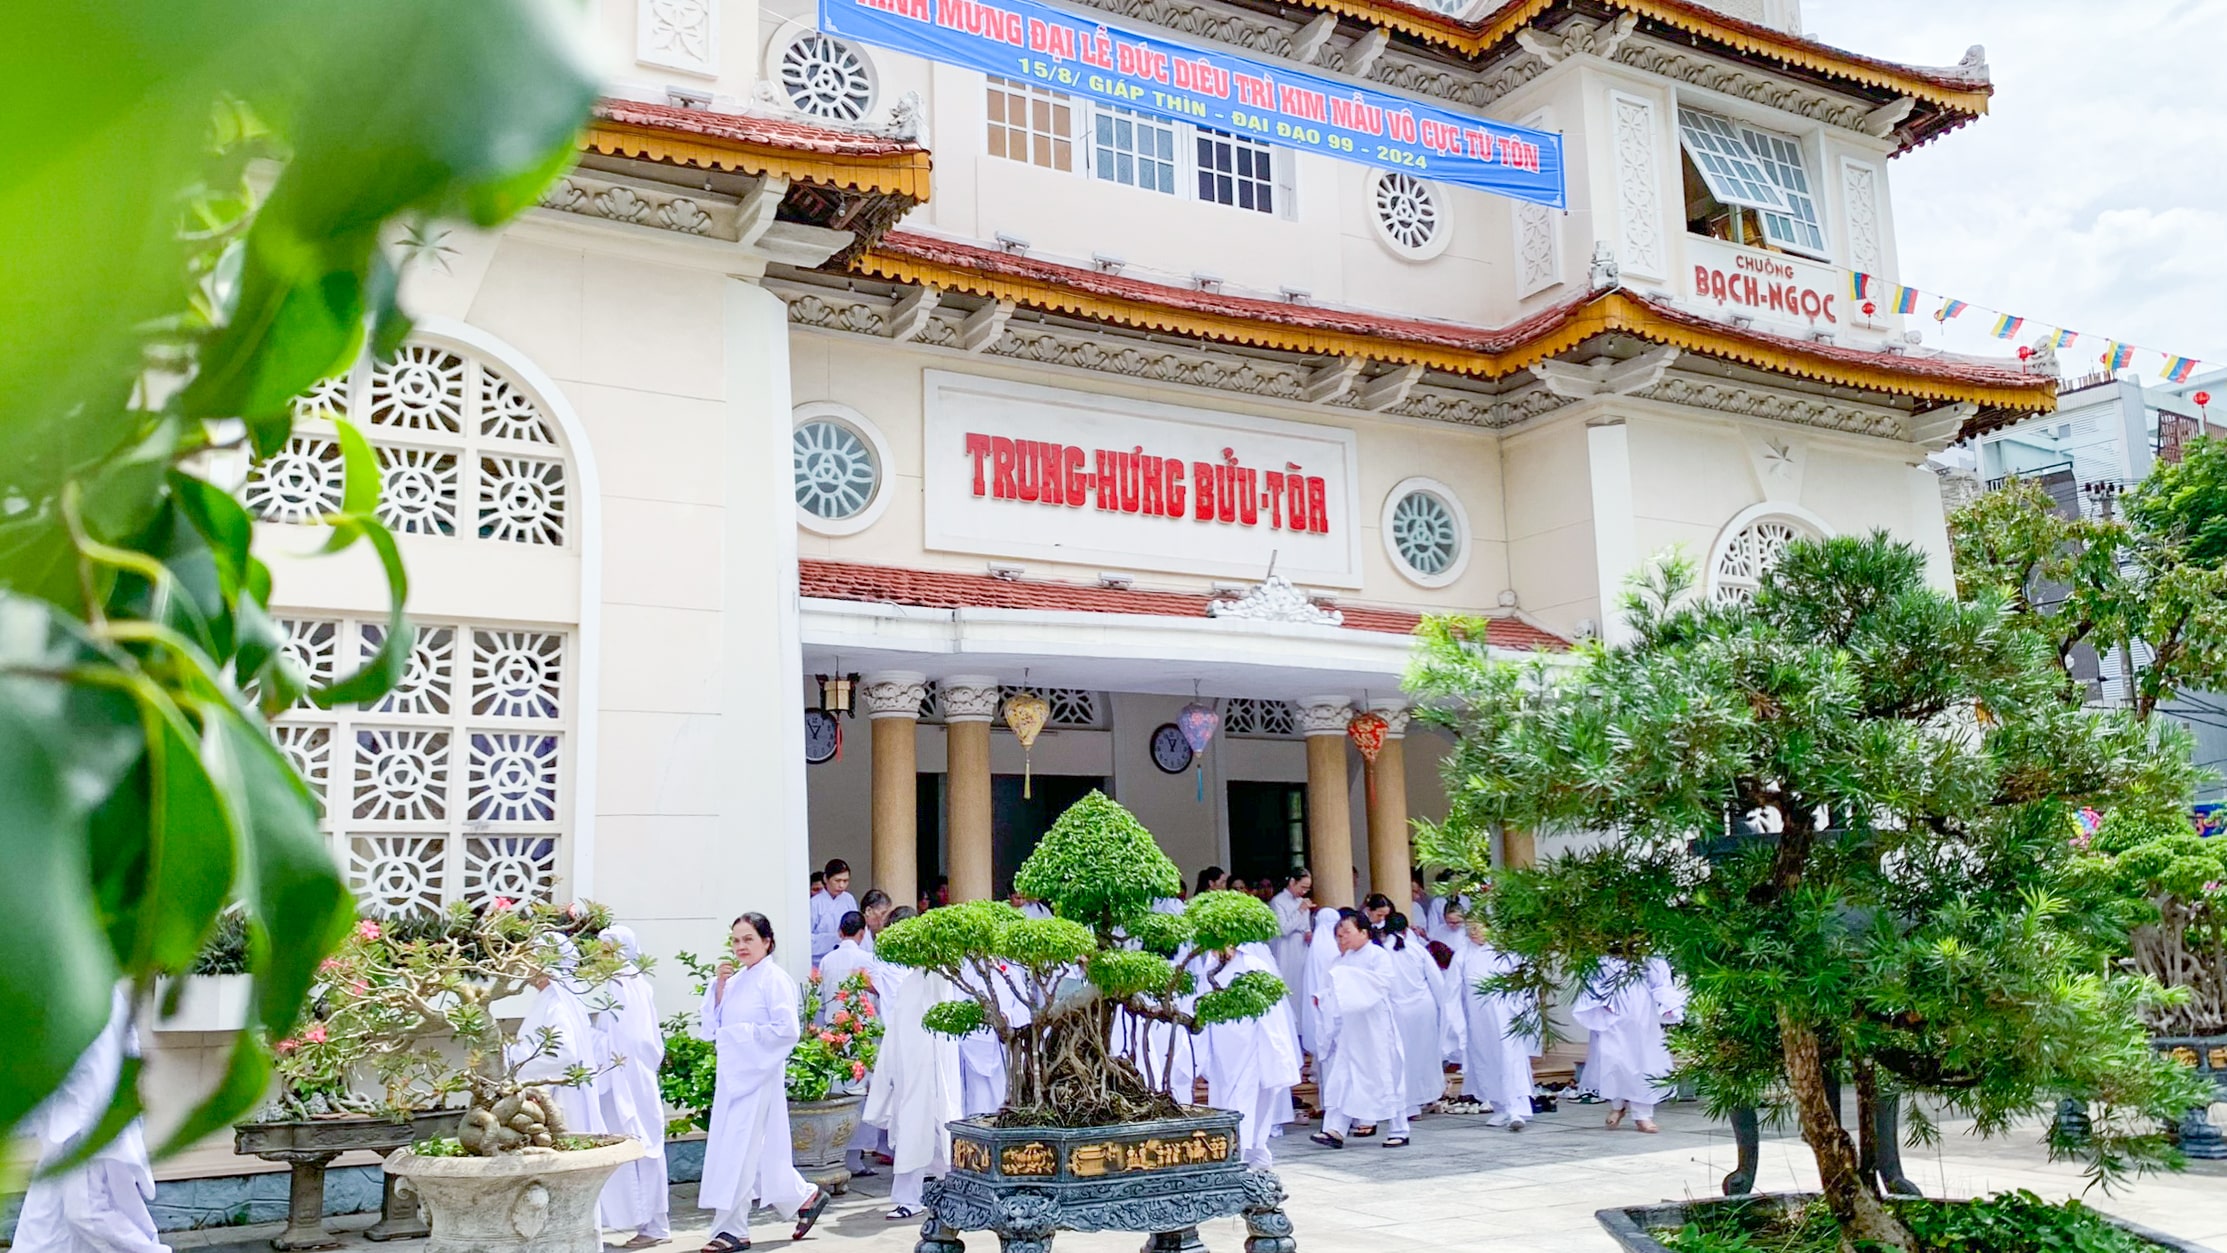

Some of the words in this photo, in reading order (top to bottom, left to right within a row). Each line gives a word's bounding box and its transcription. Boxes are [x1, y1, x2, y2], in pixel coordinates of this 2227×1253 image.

[1018, 58, 1081, 86] 15/8/
[1089, 75, 1144, 100] GIÁP
[1152, 91, 1207, 117] THÌN
[1231, 111, 1269, 133] ĐẠI
[1276, 121, 1320, 144] ĐẠO
[1328, 134, 1353, 153] 99
[1377, 145, 1428, 170] 2024
[1029, 18, 1075, 62] ĐẠI
[1081, 25, 1112, 69] LỄ
[1117, 42, 1168, 84] ĐỨC
[1173, 57, 1229, 99] DIÊU
[1234, 75, 1276, 111] TRÌ
[1279, 84, 1327, 122] KIM
[1331, 92, 1382, 135] MẪU
[1387, 108, 1416, 144] VÔ
[1421, 119, 1461, 156] CỰC
[1464, 127, 1494, 161] TỪ
[1497, 135, 1540, 173] TÔN
[1736, 255, 1794, 279] CHUÔNG
